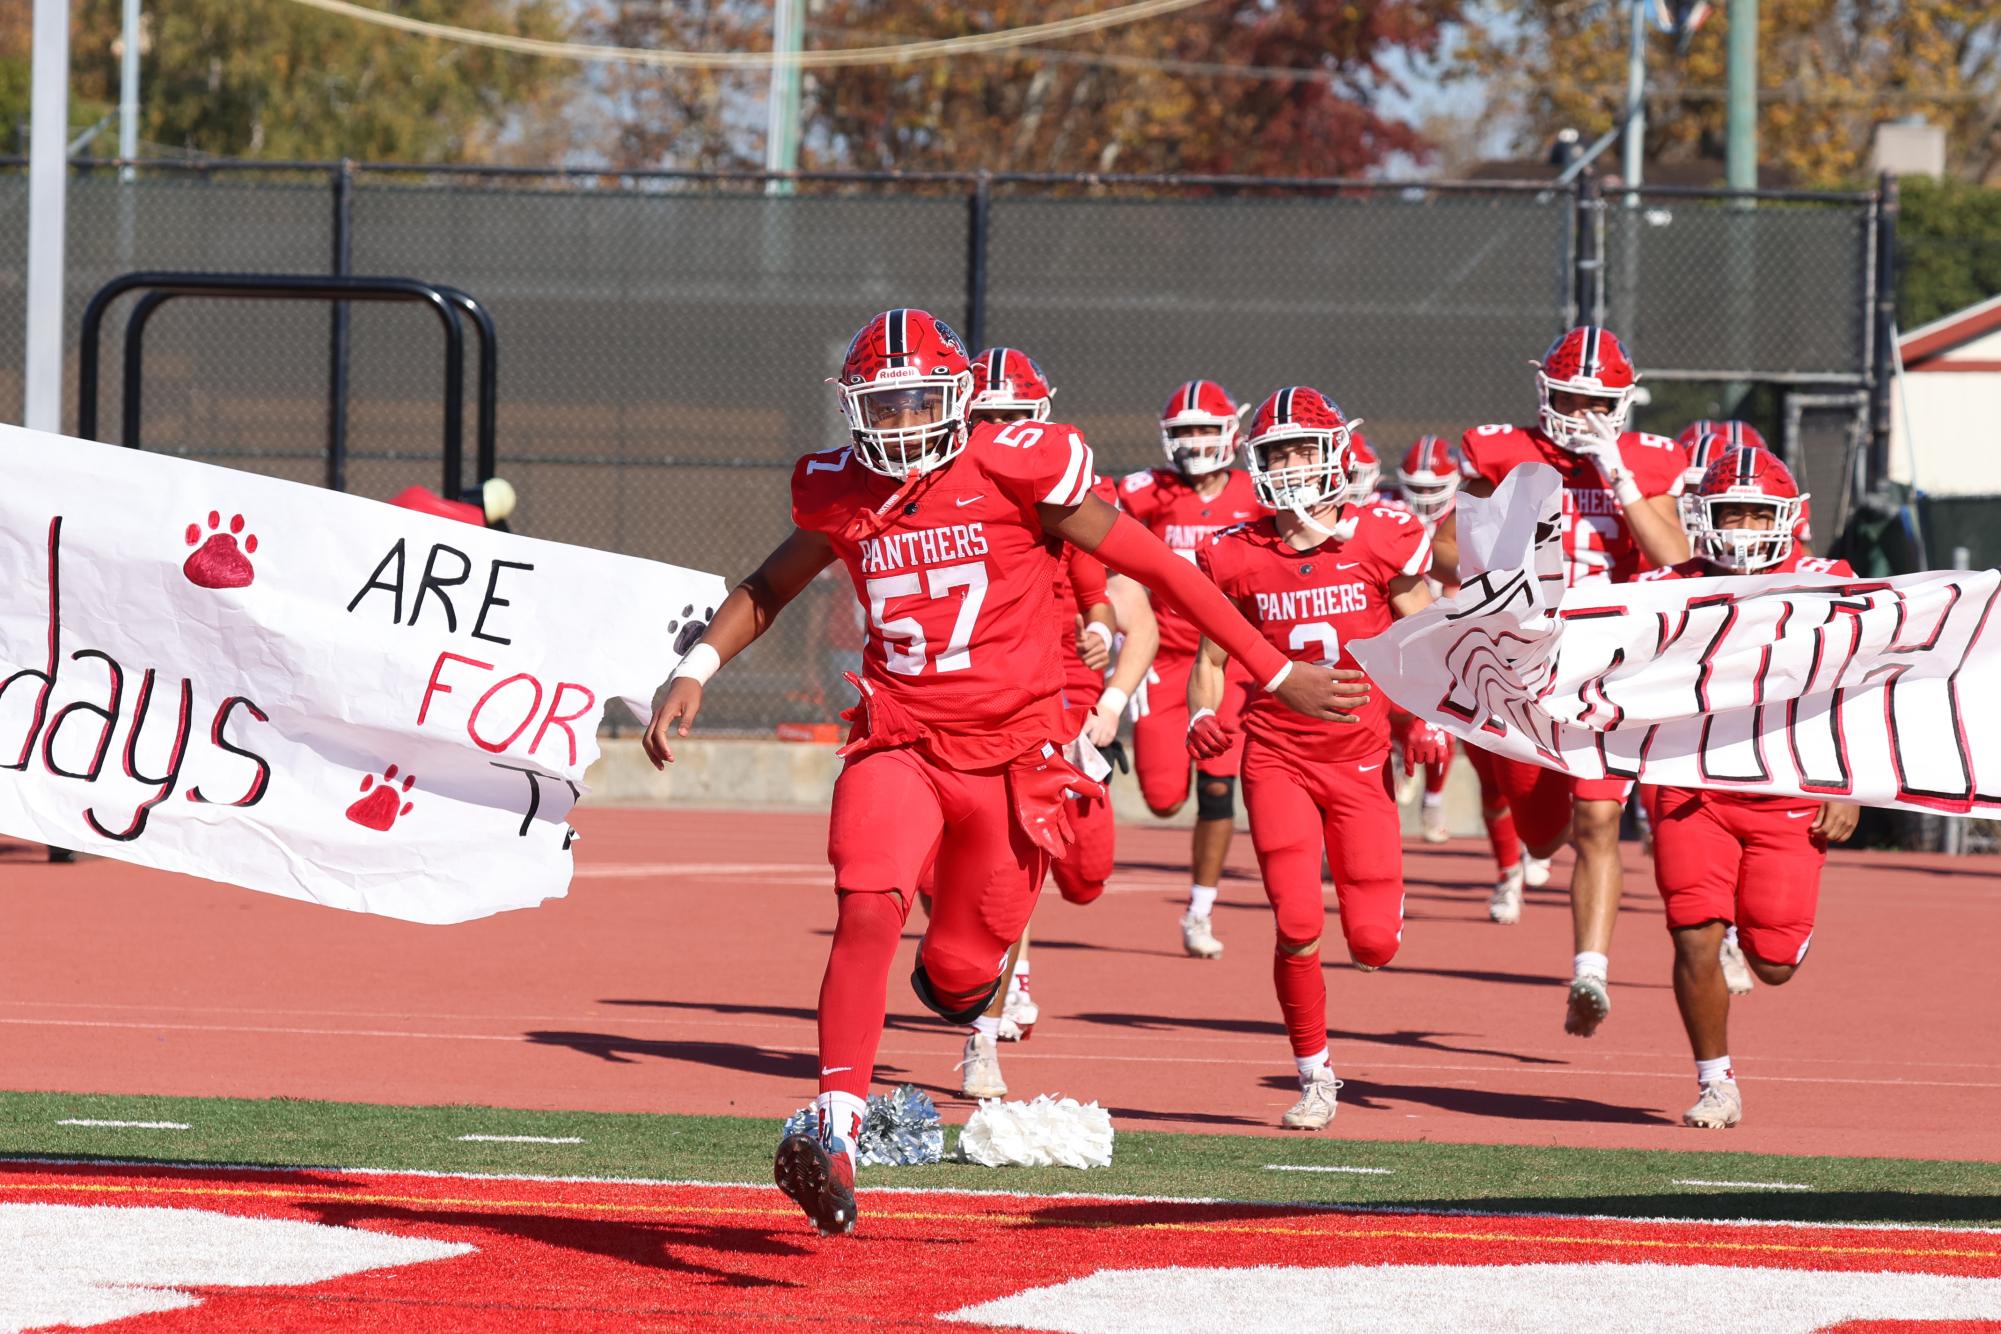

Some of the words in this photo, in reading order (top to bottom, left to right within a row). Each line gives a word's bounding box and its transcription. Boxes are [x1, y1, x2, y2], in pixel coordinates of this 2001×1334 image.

[880, 369, 915, 379] Riddell
[858, 522, 989, 573] PANTHERS
[347, 538, 534, 645] ARE
[866, 560, 989, 676] 57
[1255, 582, 1368, 621] PANTHERS
[417, 651, 595, 766] FOR
